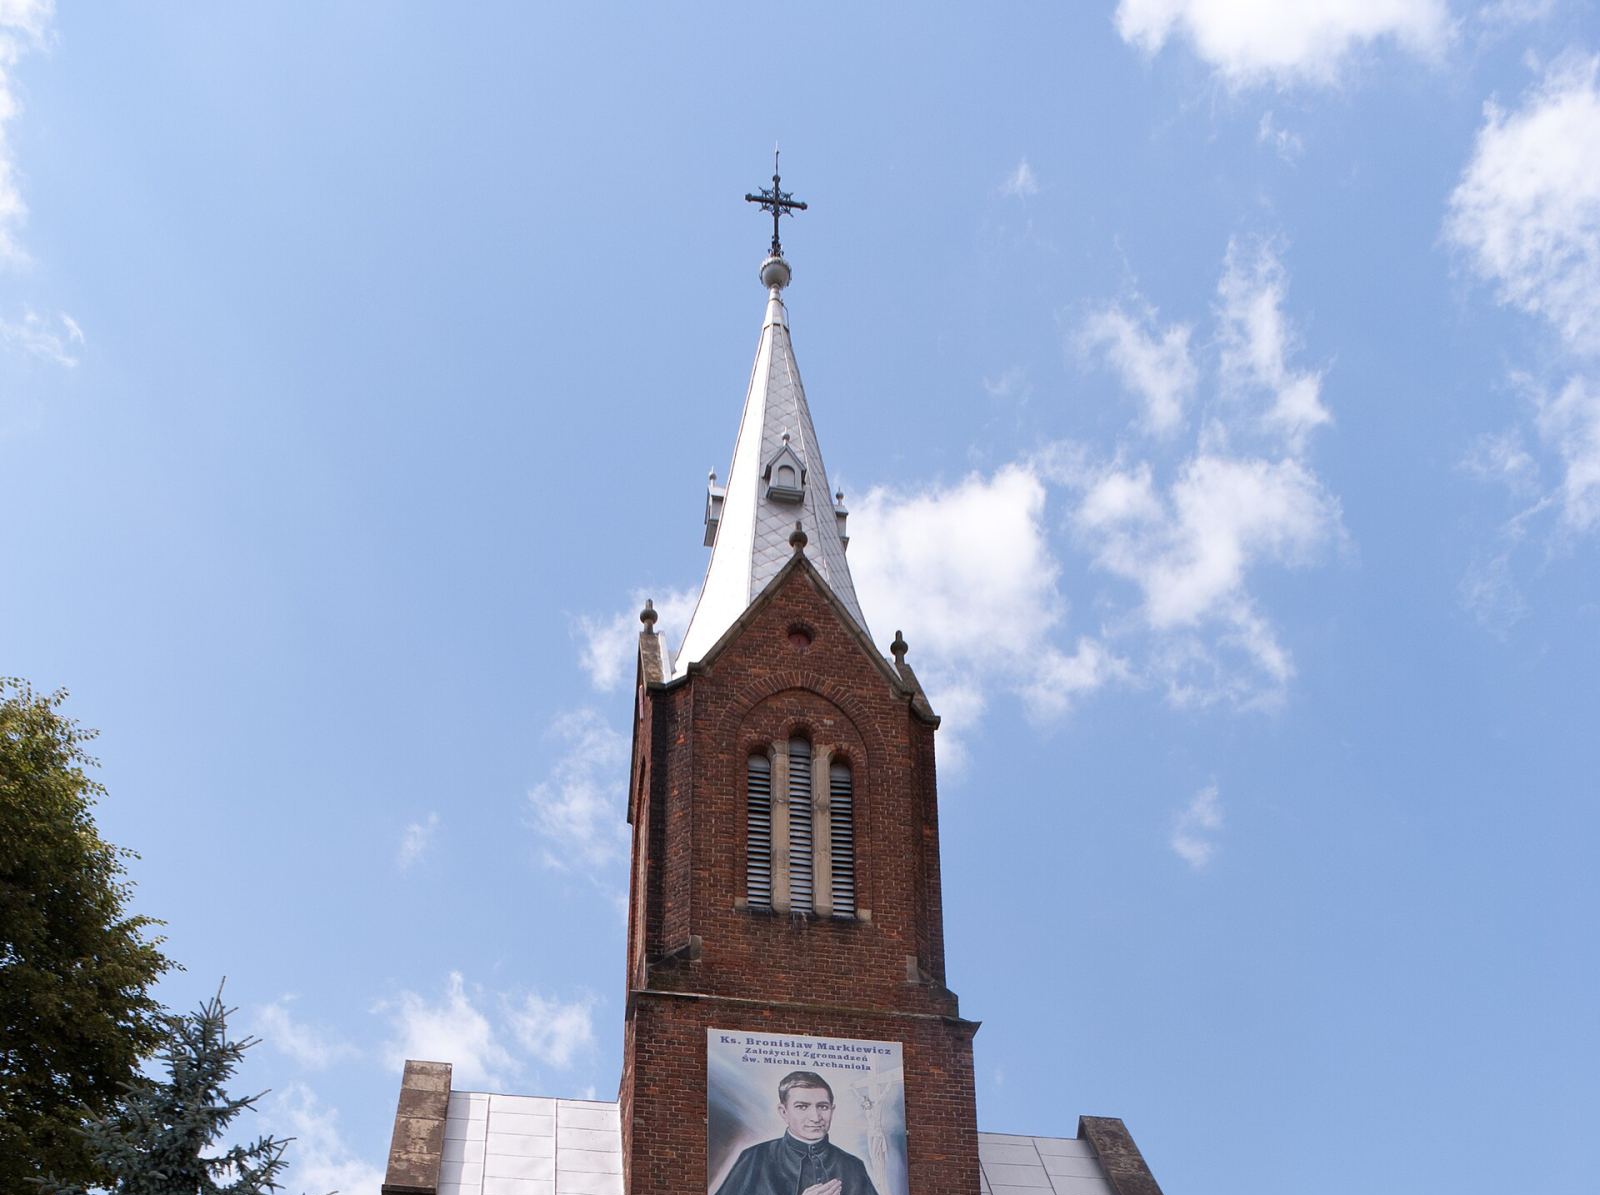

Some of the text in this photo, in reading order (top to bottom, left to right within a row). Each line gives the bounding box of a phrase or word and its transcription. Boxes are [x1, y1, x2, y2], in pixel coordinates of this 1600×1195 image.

[719, 1036, 892, 1056] Ks. Bronisław Markiewicz
[741, 1054, 760, 1064] Św.
